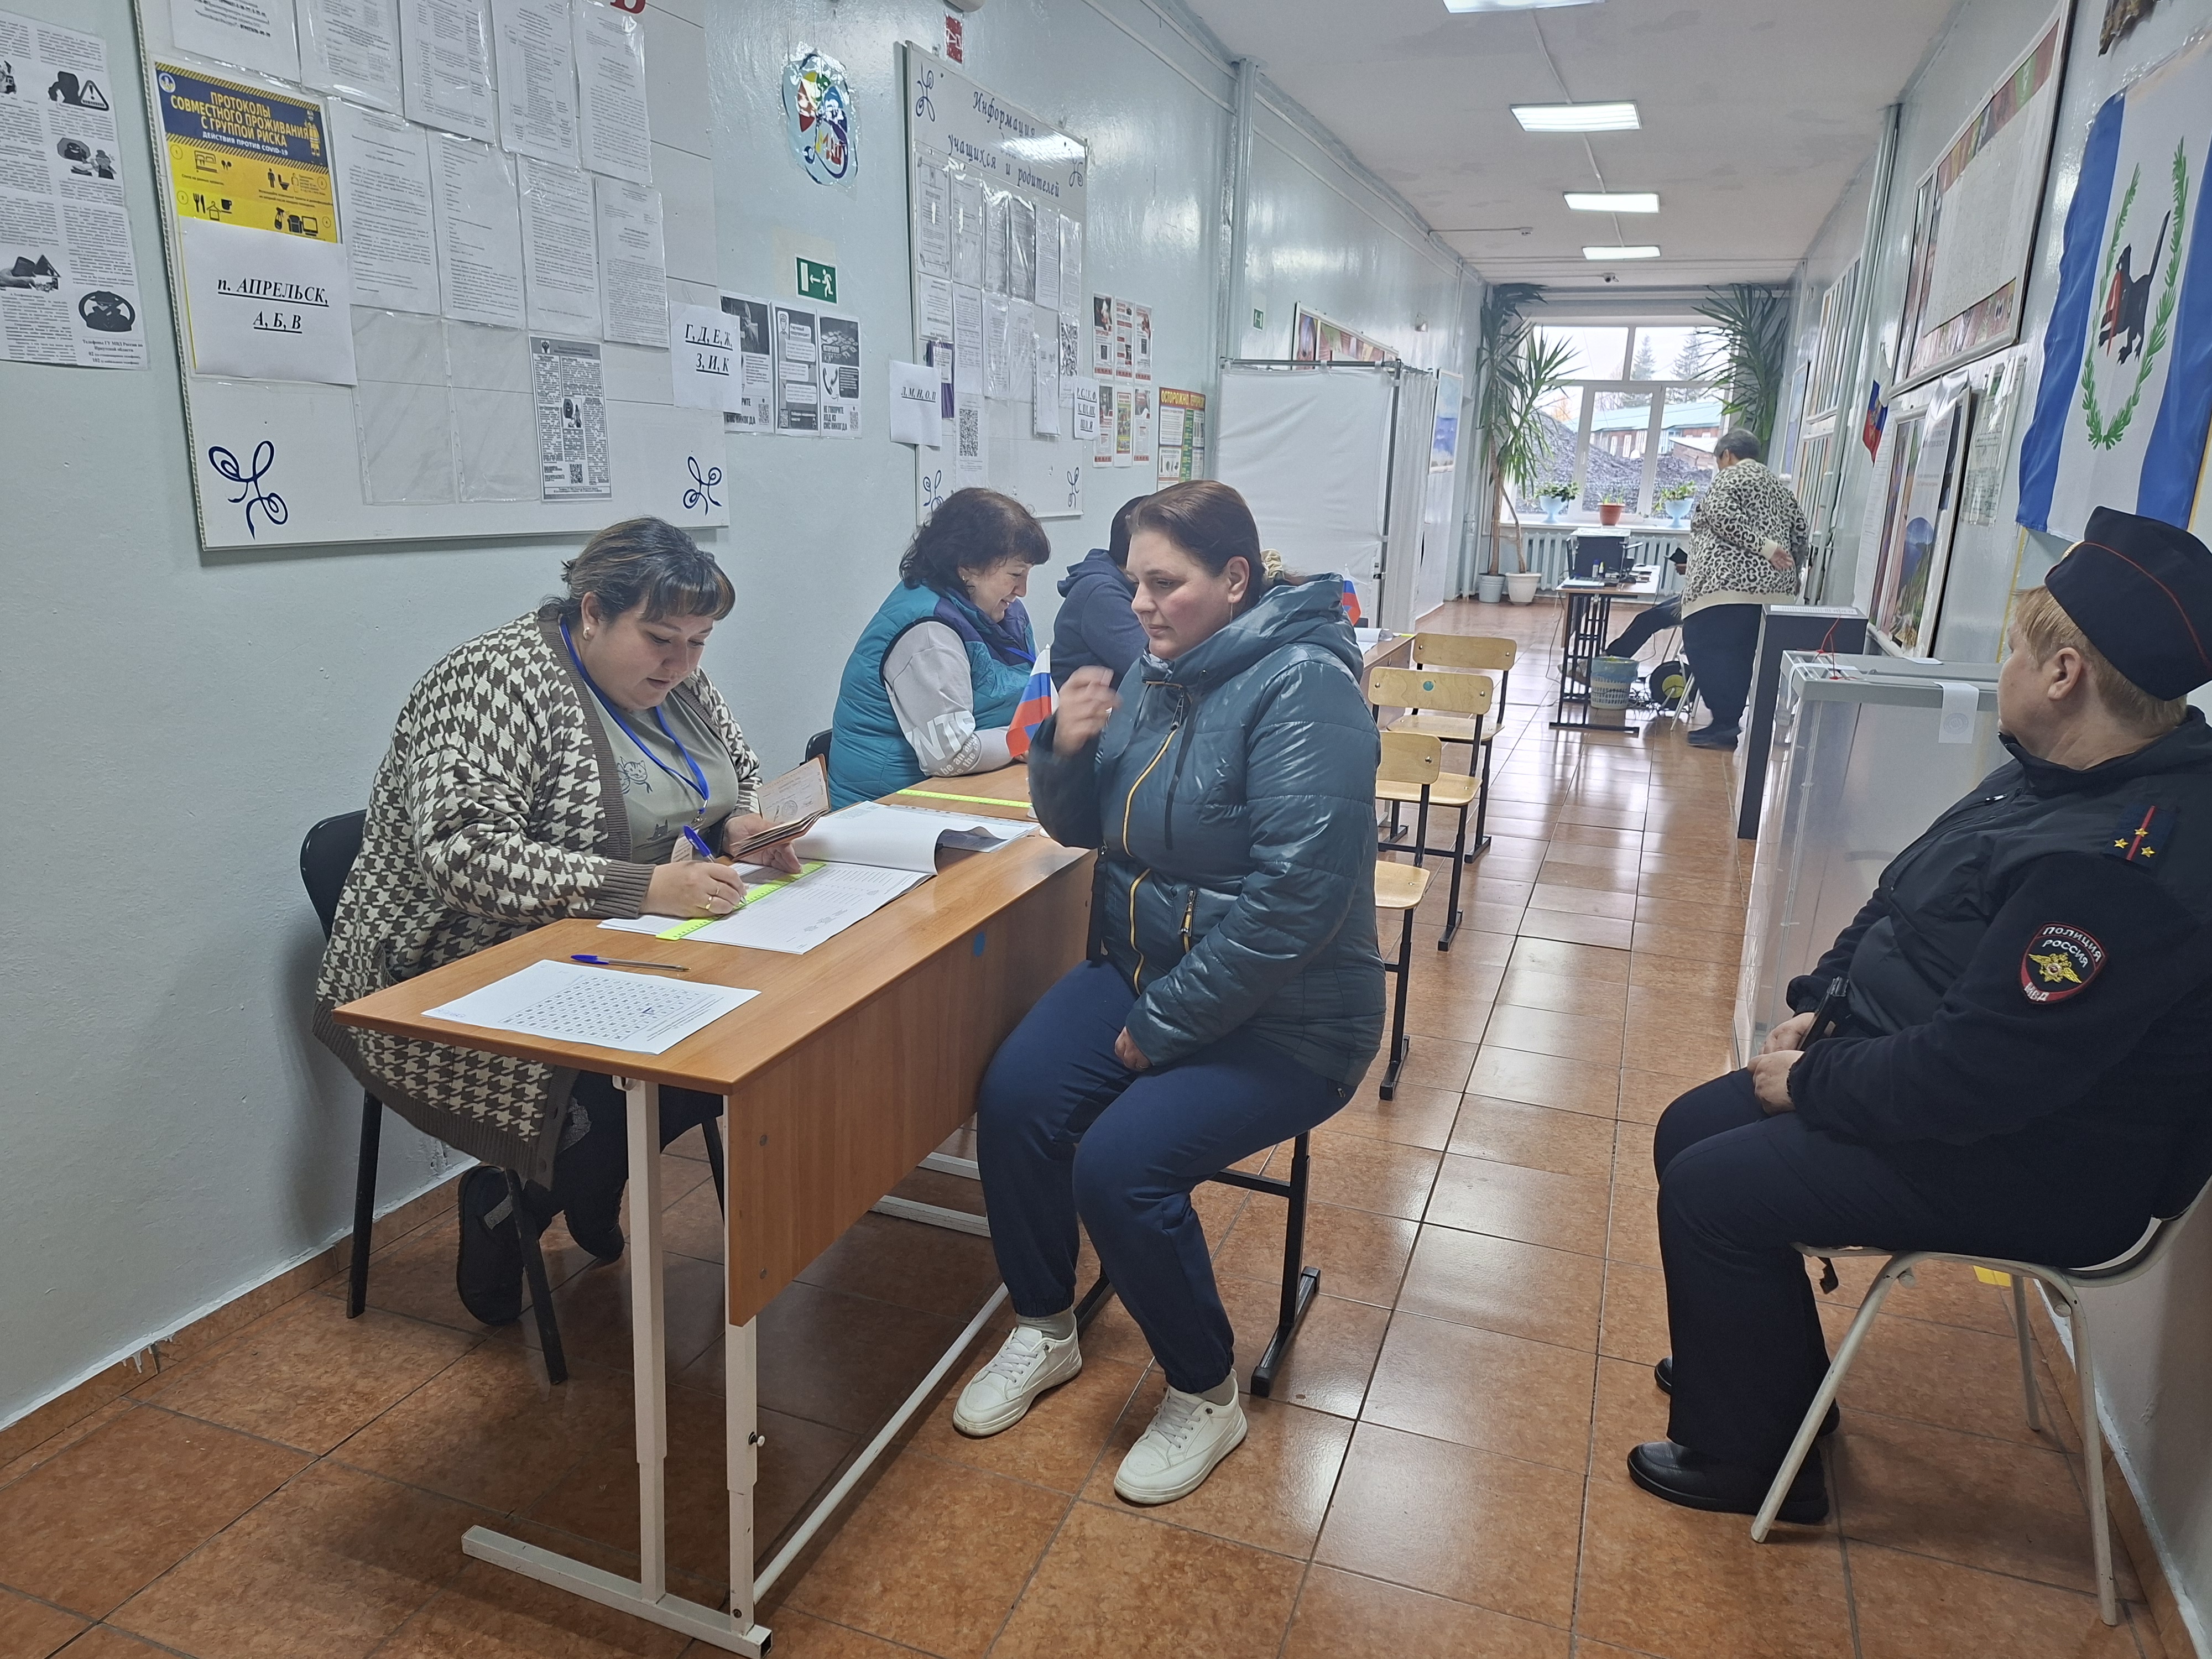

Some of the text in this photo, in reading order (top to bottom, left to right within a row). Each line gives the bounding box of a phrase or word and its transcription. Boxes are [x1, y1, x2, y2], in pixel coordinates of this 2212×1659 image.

[210, 91, 271, 118] ПРОТОКОЛЫ
[973, 91, 1035, 137] Информация
[170, 95, 310, 140] СОВМЕСТНОГО ПРОЖИВАНИЯ
[201, 116, 208, 129] С
[257, 131, 288, 148] РИСКА
[202, 131, 288, 156] ДЕЙСТВИЯ ПРОТИВ COVID-19
[948, 134, 997, 169] учащихся
[1005, 163, 1011, 176] и
[1017, 165, 1060, 197] родителей
[237, 278, 328, 304] АПРЕЛЬСК,
[253, 310, 301, 330] А, Б, В
[685, 324, 733, 348] Г, Д, Е, Ж,
[696, 353, 705, 370] З,
[708, 354, 719, 372] И,
[722, 357, 729, 372] К
[742, 398, 751, 406] РИТЕ
[932, 392, 936, 400] П
[953, 753, 965, 765] an
[963, 753, 975, 768] the
[2042, 940, 2088, 968] РОССИЯ
[2043, 927, 2102, 962] ПОЛИЦИЯ
[2024, 982, 2050, 1001] МВД
